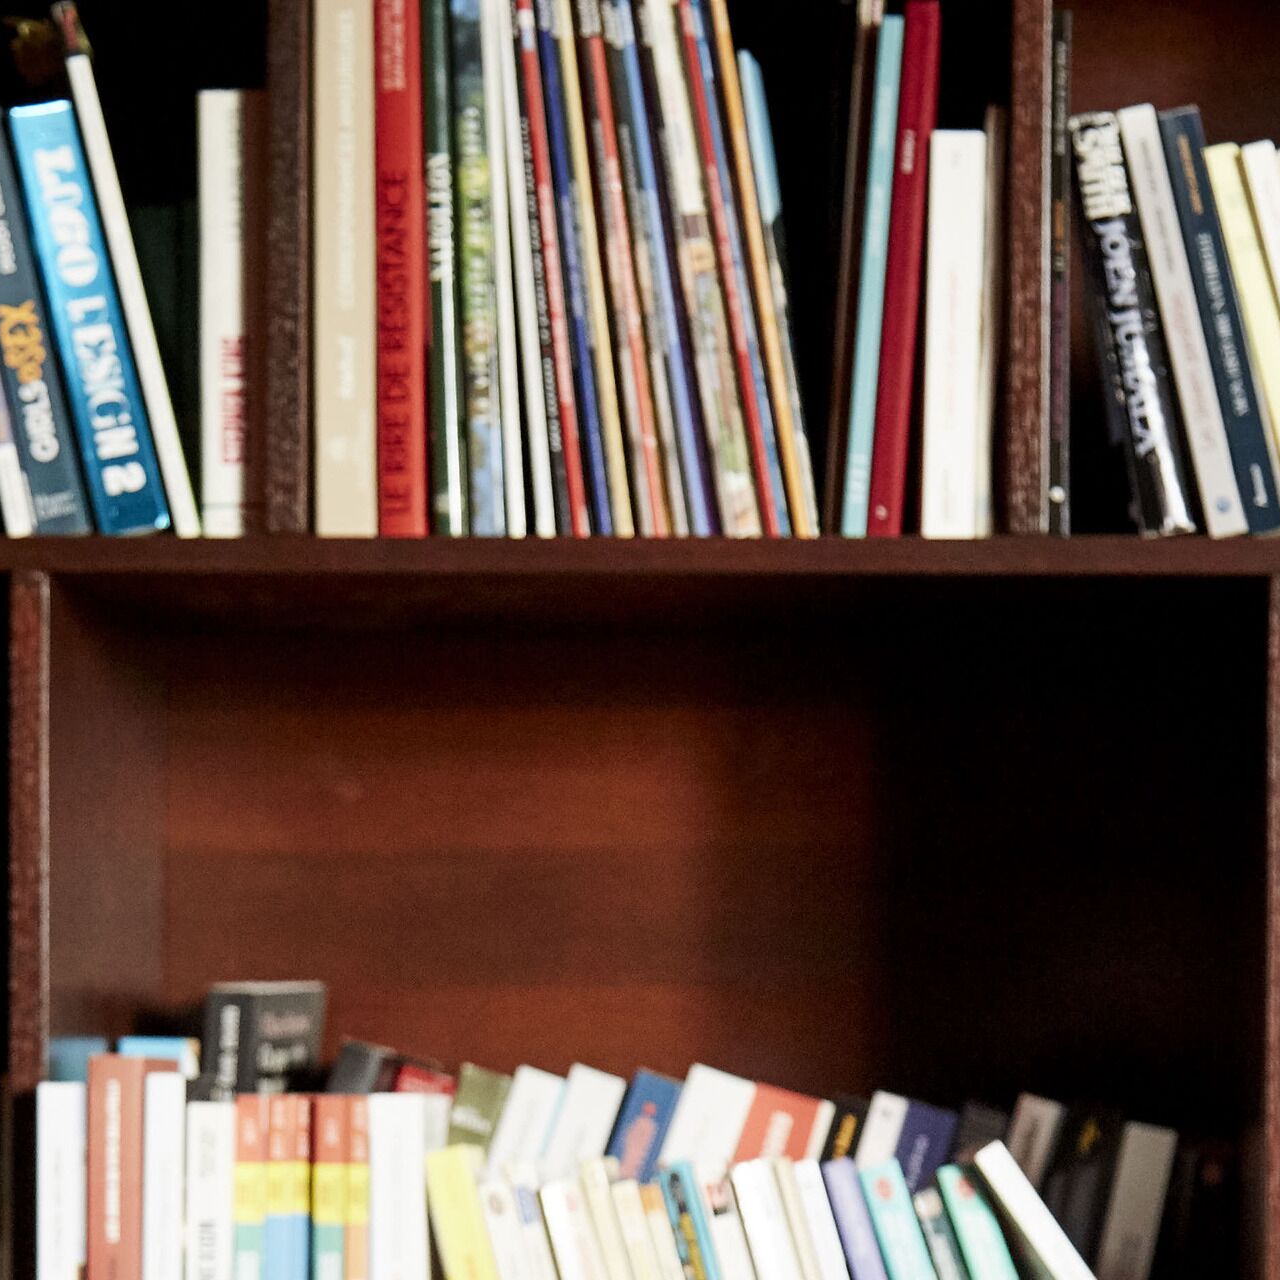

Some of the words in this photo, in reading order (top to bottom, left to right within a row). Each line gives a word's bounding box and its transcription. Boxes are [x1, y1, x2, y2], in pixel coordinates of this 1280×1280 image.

[34, 147, 98, 288] LOGO
[66, 295, 139, 460] DESIGN
[103, 463, 146, 497] 2
[383, 363, 408, 404] DE
[20, 381, 59, 463] GIRLS
[384, 487, 409, 516] LE
